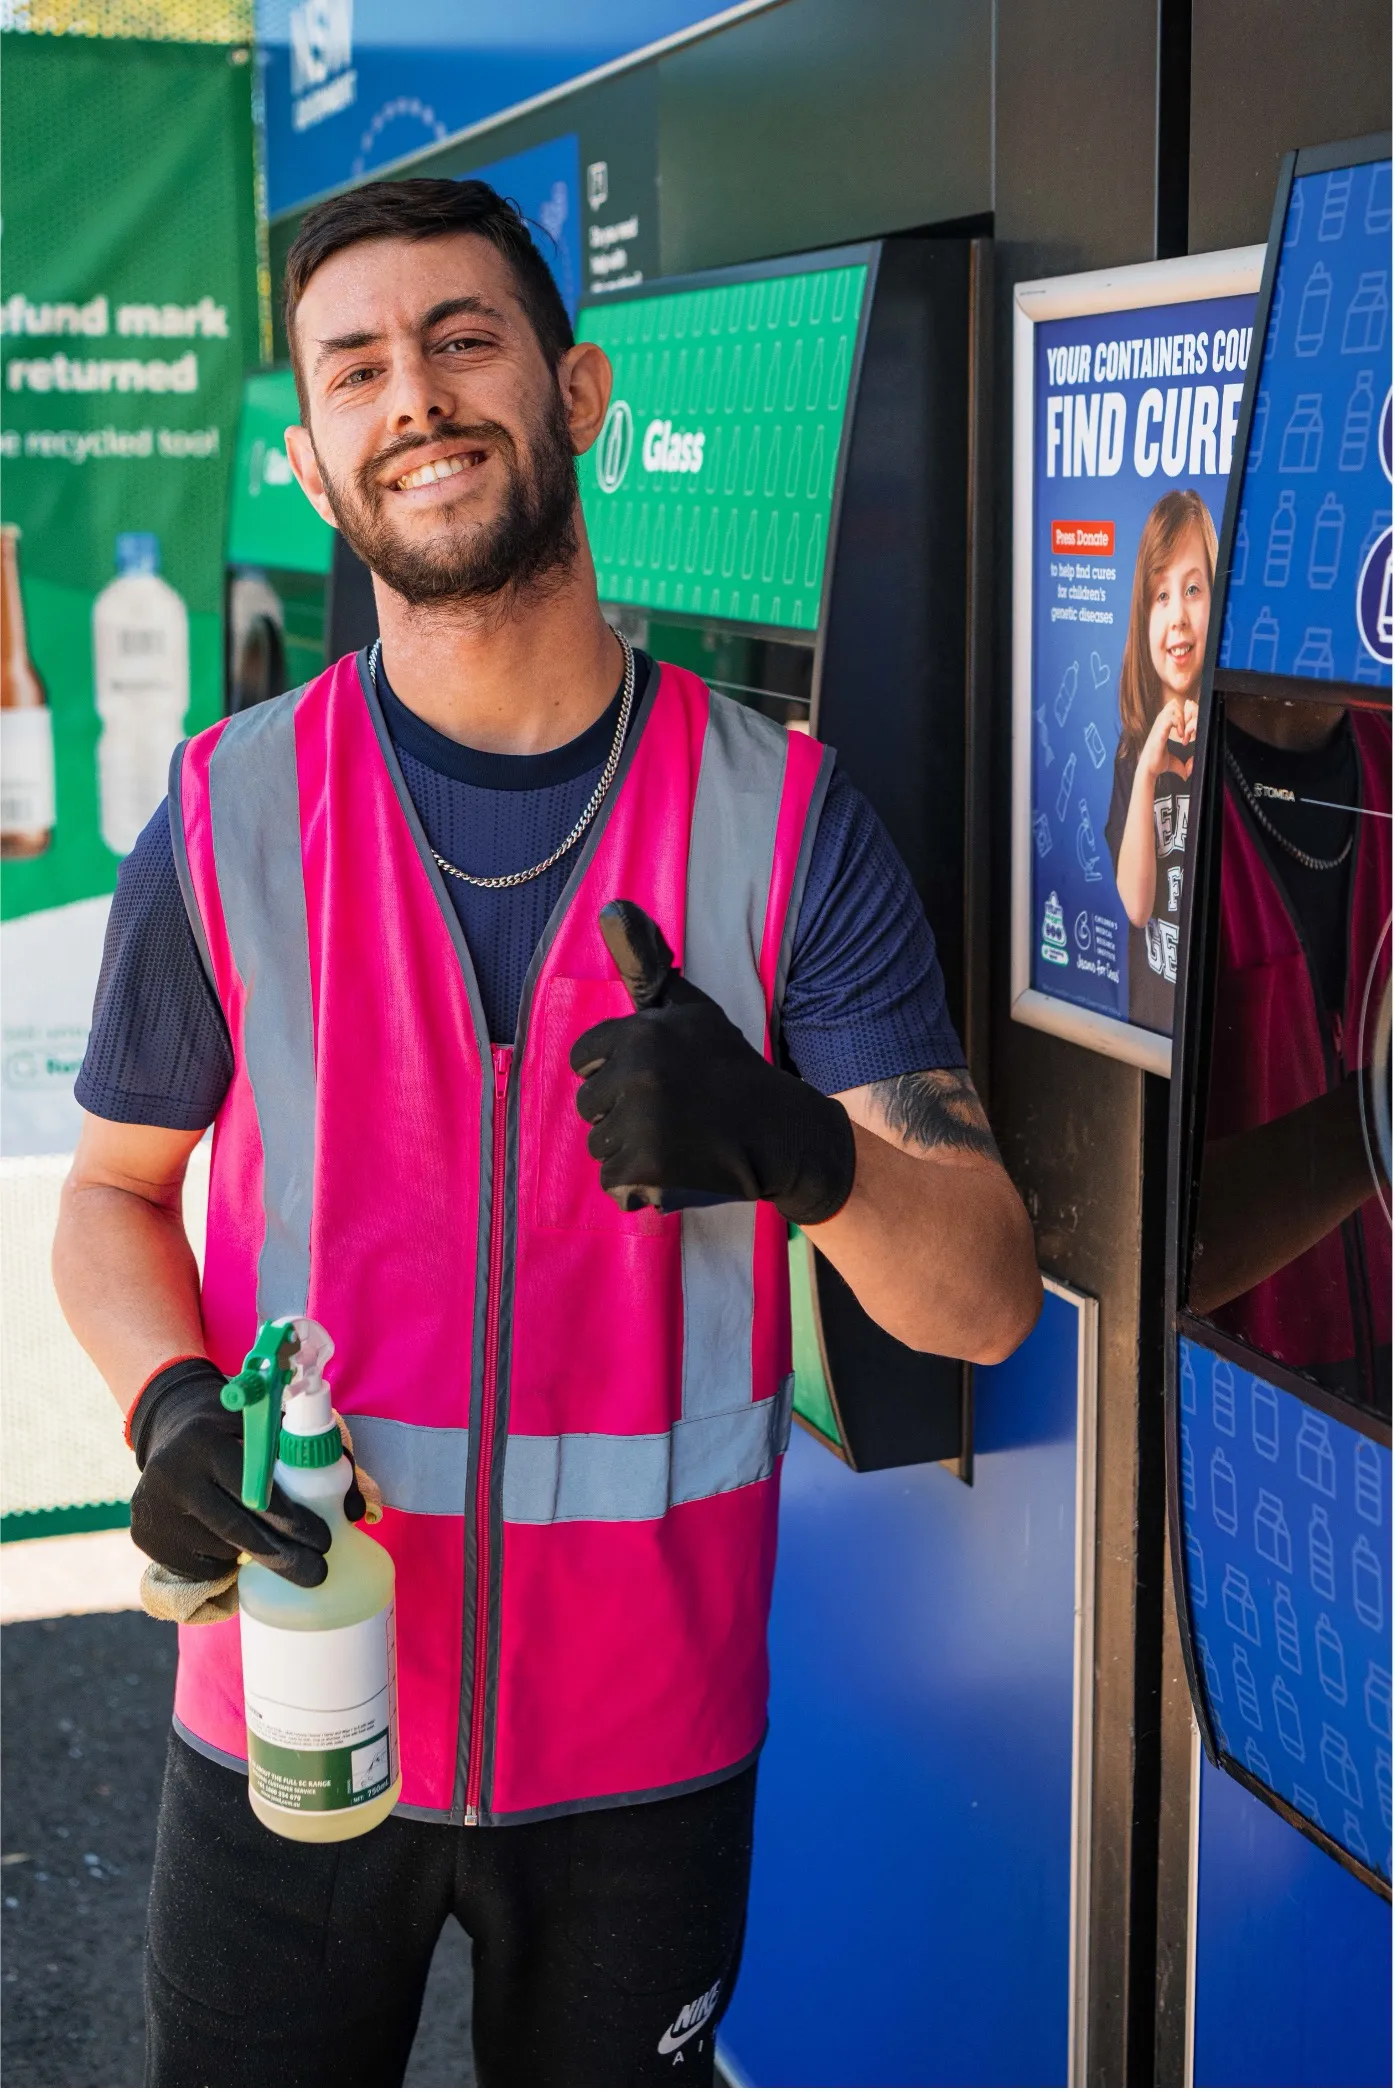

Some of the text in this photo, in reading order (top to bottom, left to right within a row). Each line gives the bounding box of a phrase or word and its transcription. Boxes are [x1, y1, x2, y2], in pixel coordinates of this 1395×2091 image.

[1, 294, 229, 337] fund mark
[9, 353, 197, 392] returned
[1047, 327, 1253, 386] YOUR CONTAINERS COU
[27, 427, 152, 464] recycled
[642, 418, 706, 474] Glass
[1047, 384, 1244, 478] FIND CURE
[1056, 529, 1109, 547] Press Donate
[1050, 561, 1116, 581] to help find cures
[1057, 584, 1106, 601] for children's
[1051, 606, 1113, 624] genetic diseases
[673, 1979, 720, 2033] NIKE
